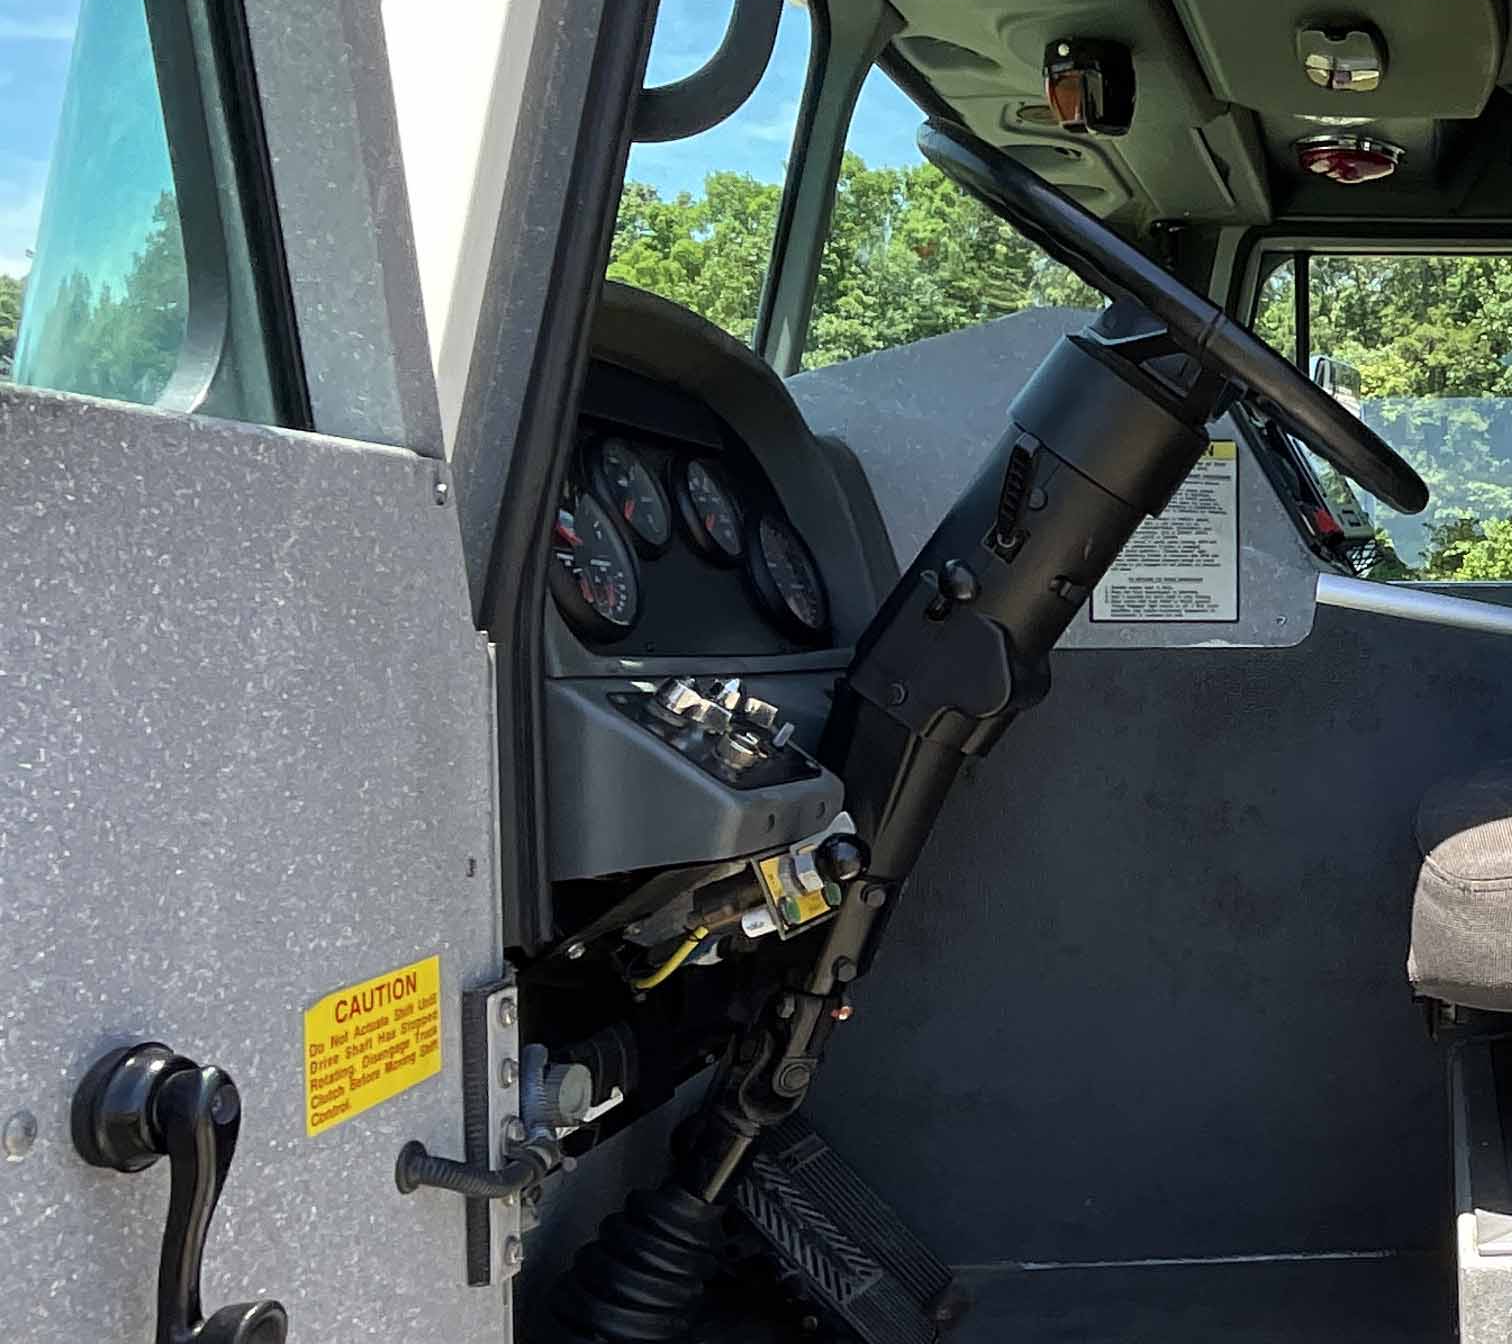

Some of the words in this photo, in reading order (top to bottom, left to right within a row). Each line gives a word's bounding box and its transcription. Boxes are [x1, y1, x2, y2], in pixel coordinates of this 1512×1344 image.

[335, 972, 417, 1023] CAUTION
[309, 1043, 324, 1057] Do
[331, 1032, 348, 1049] Not
[310, 1054, 338, 1074] Drive
[345, 1037, 373, 1059] Shaft
[378, 1030, 396, 1046] Has
[311, 1085, 345, 1109] Clutch
[350, 1070, 380, 1091] Before
